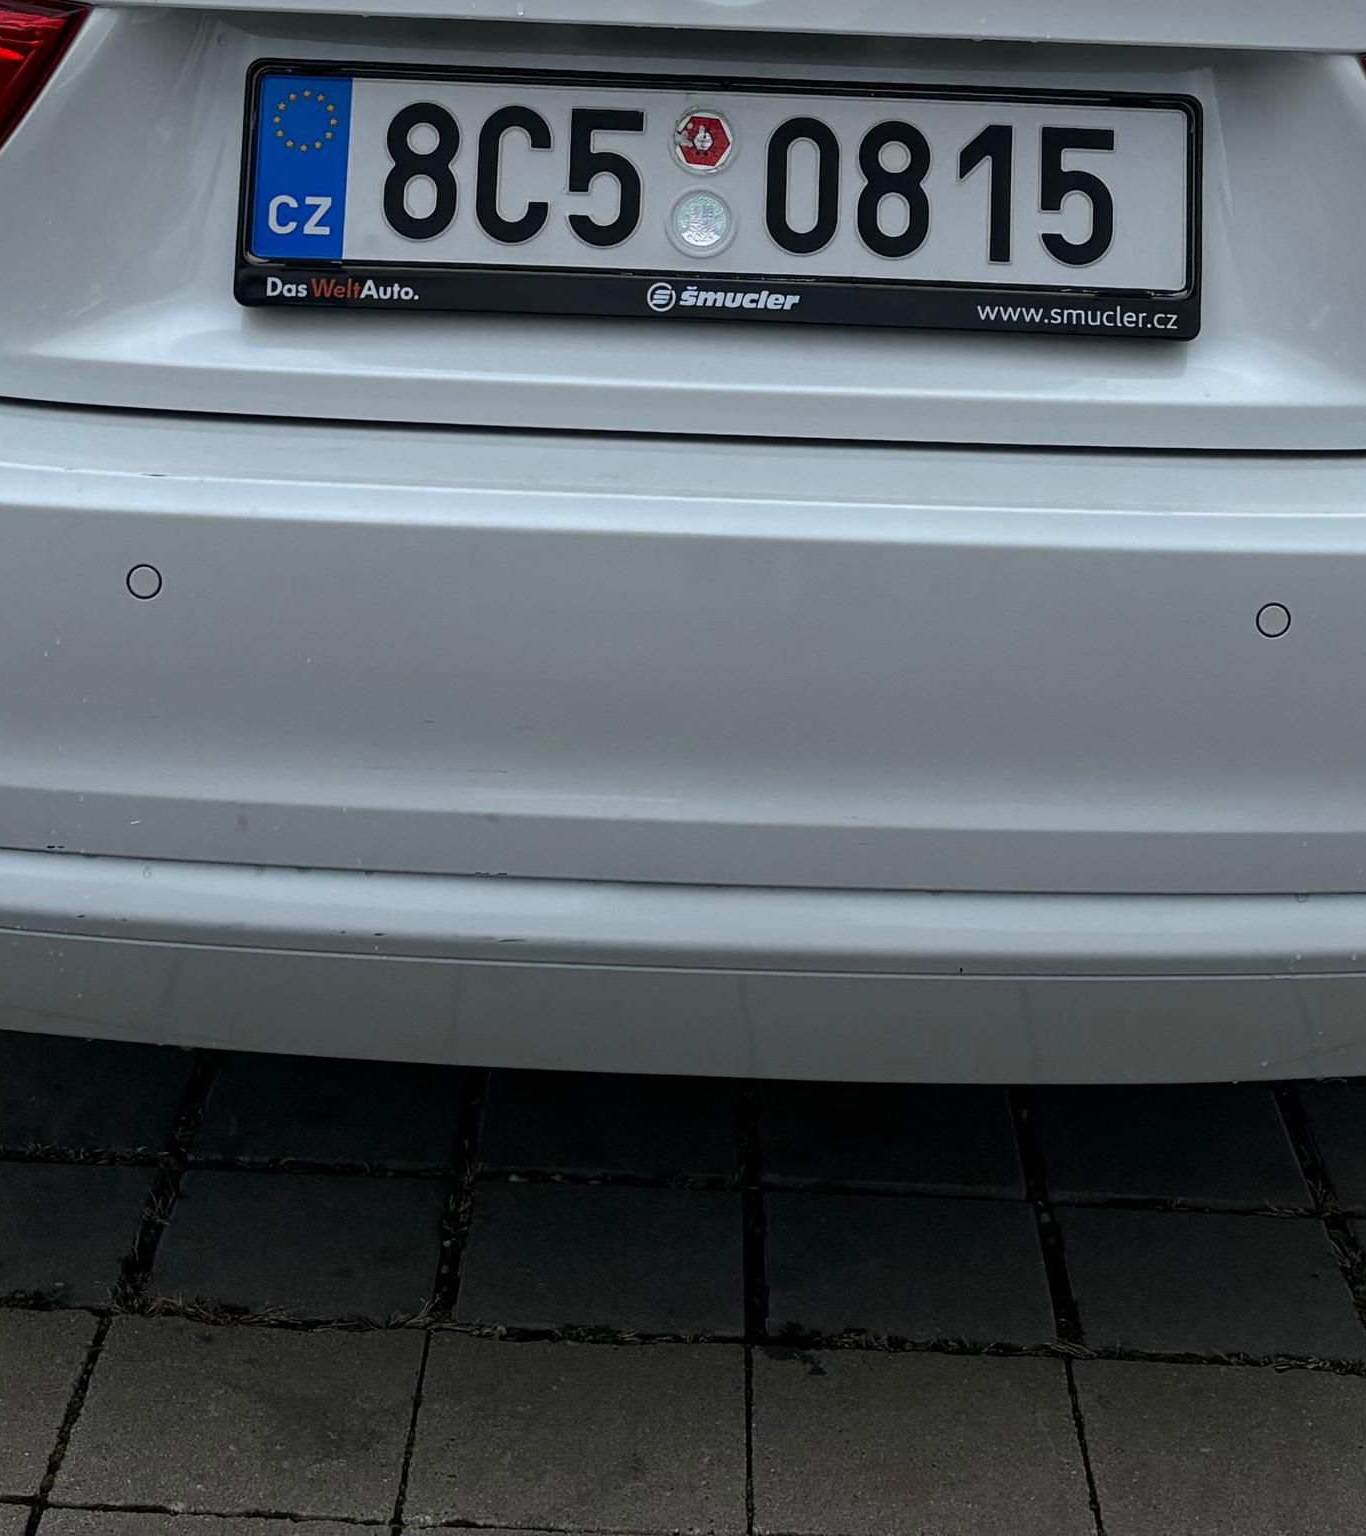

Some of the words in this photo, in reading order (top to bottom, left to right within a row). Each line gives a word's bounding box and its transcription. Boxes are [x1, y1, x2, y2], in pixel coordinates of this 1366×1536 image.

[383, 101, 645, 247] 8C5
[765, 116, 1116, 266] 0815
[268, 194, 333, 235] CZ
[266, 277, 308, 297] Das
[679, 286, 801, 310] šmucler
[977, 305, 1178, 329] www.smucler.cz
